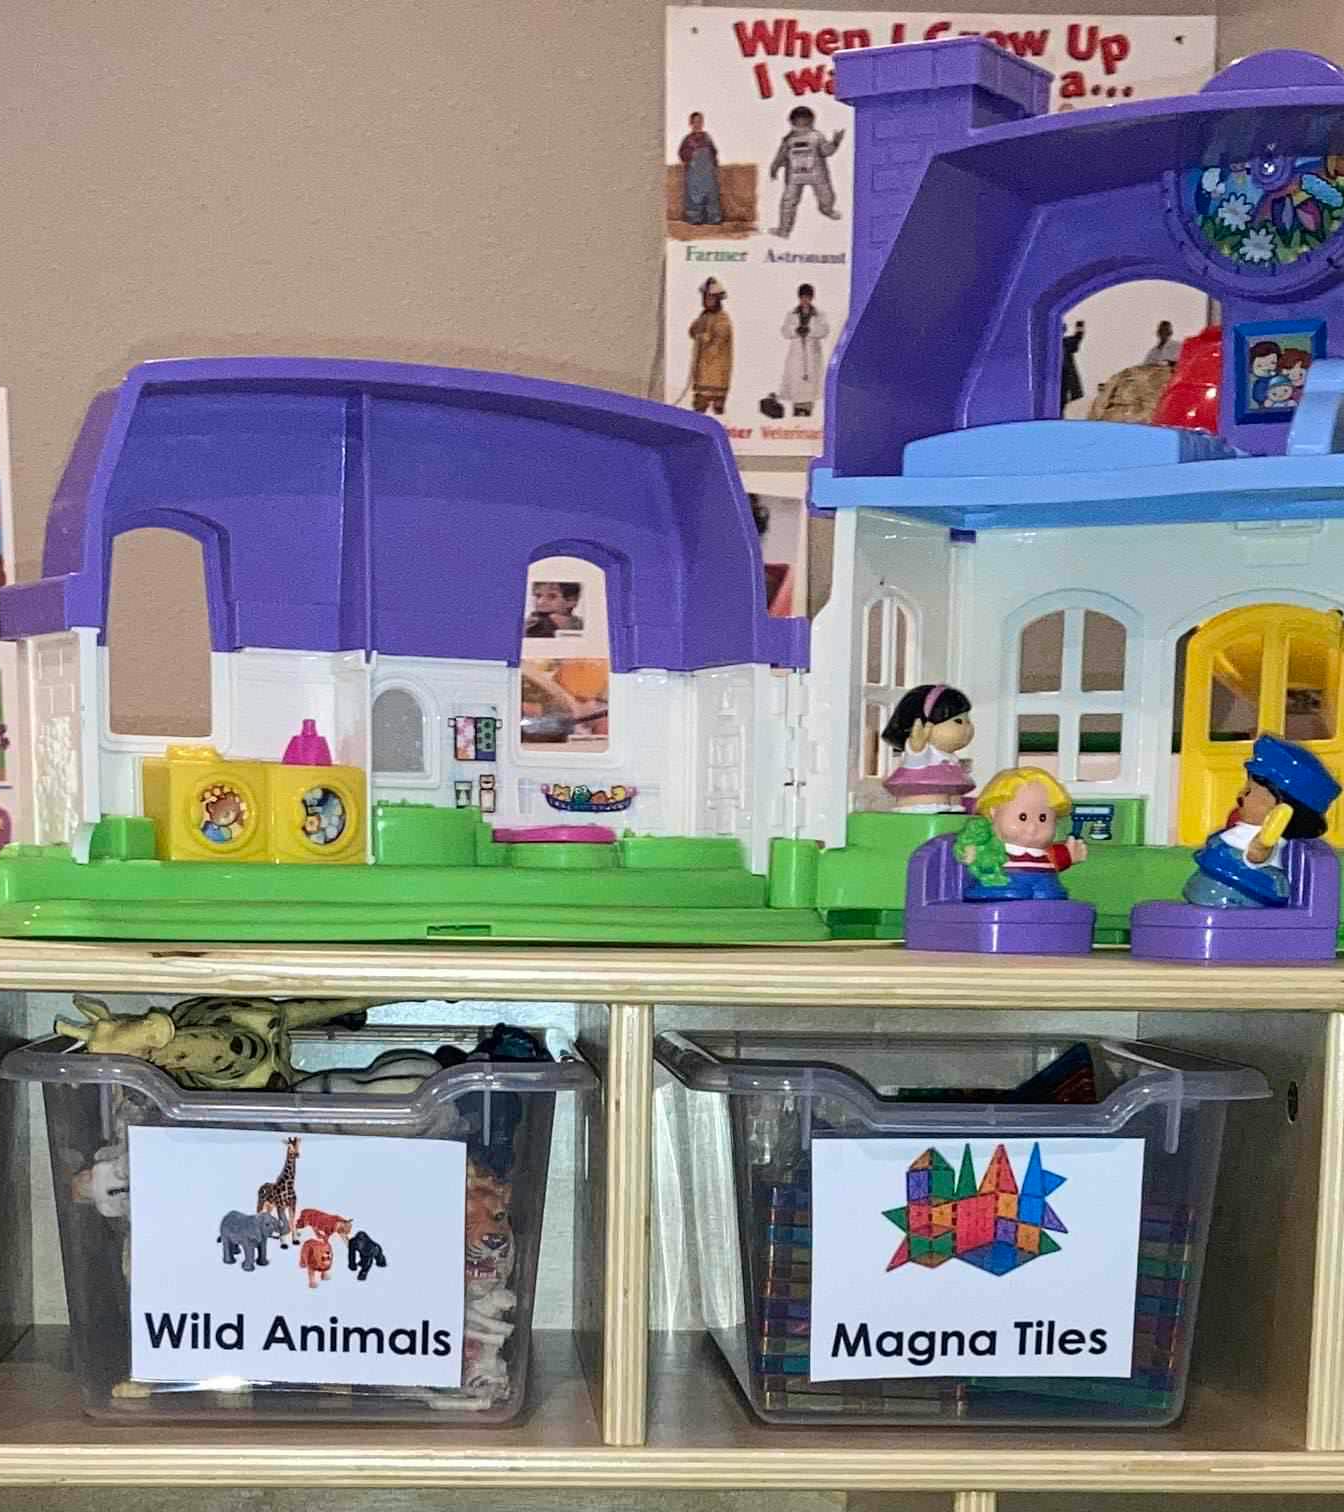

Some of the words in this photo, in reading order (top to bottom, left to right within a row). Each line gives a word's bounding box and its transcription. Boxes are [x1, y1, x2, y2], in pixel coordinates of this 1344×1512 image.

[734, 19, 870, 58] When
[1067, 23, 1131, 74] Up
[753, 62, 773, 99] I
[145, 1312, 244, 1350] Wild
[263, 1315, 452, 1357] Animals
[831, 1321, 997, 1365] Magna
[1014, 1320, 1107, 1355] Tiles
